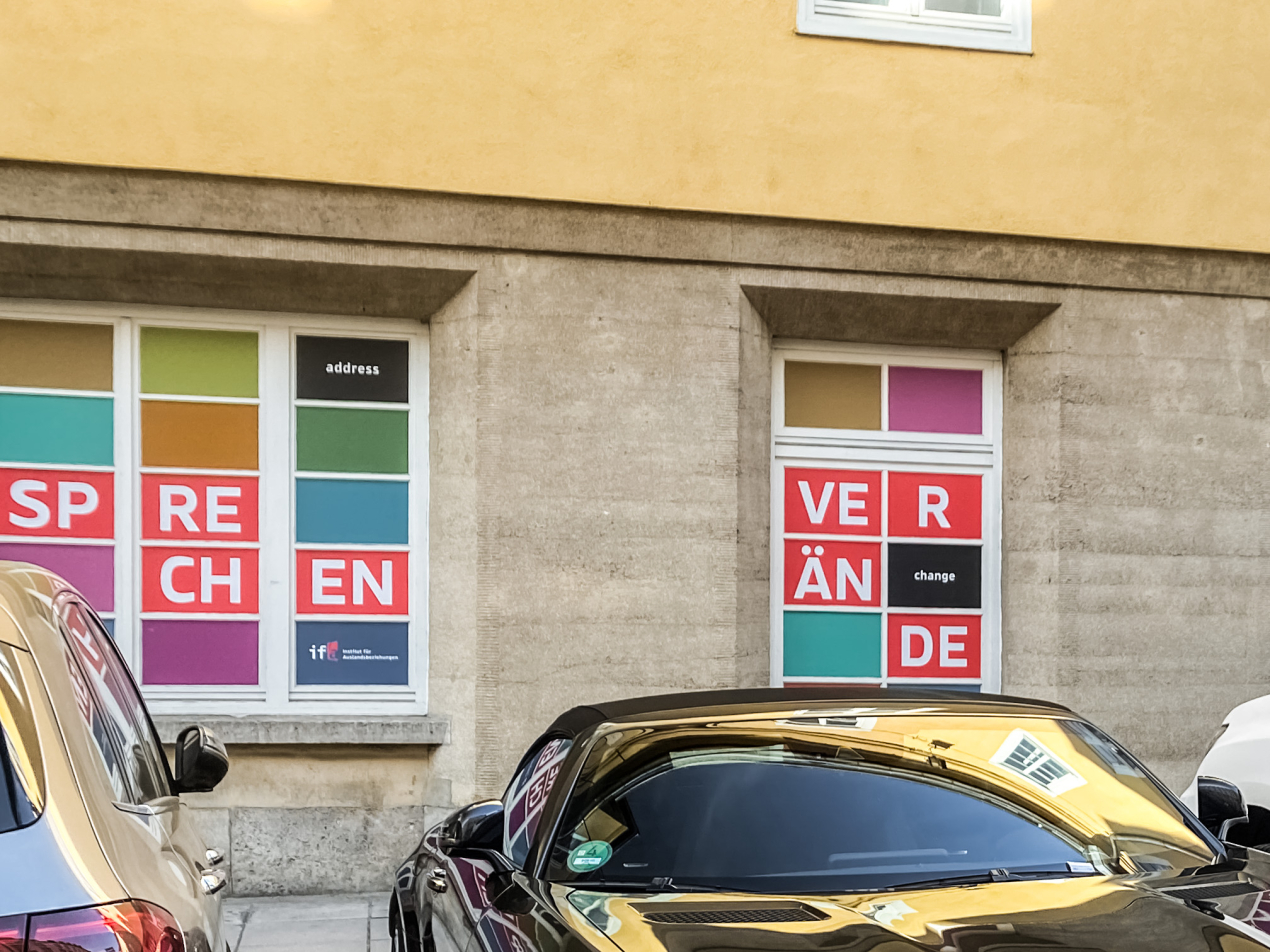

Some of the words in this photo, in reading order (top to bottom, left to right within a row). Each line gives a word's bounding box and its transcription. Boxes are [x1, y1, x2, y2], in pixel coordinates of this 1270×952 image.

[326, 361, 380, 376] address
[8, 479, 100, 529] SP
[158, 484, 242, 533] RE
[798, 481, 869, 526] VE
[918, 485, 951, 528] R
[160, 556, 242, 604] CH
[311, 559, 393, 605] EN
[793, 544, 872, 601] ÄN
[913, 569, 956, 583] change
[900, 625, 968, 667] DE
